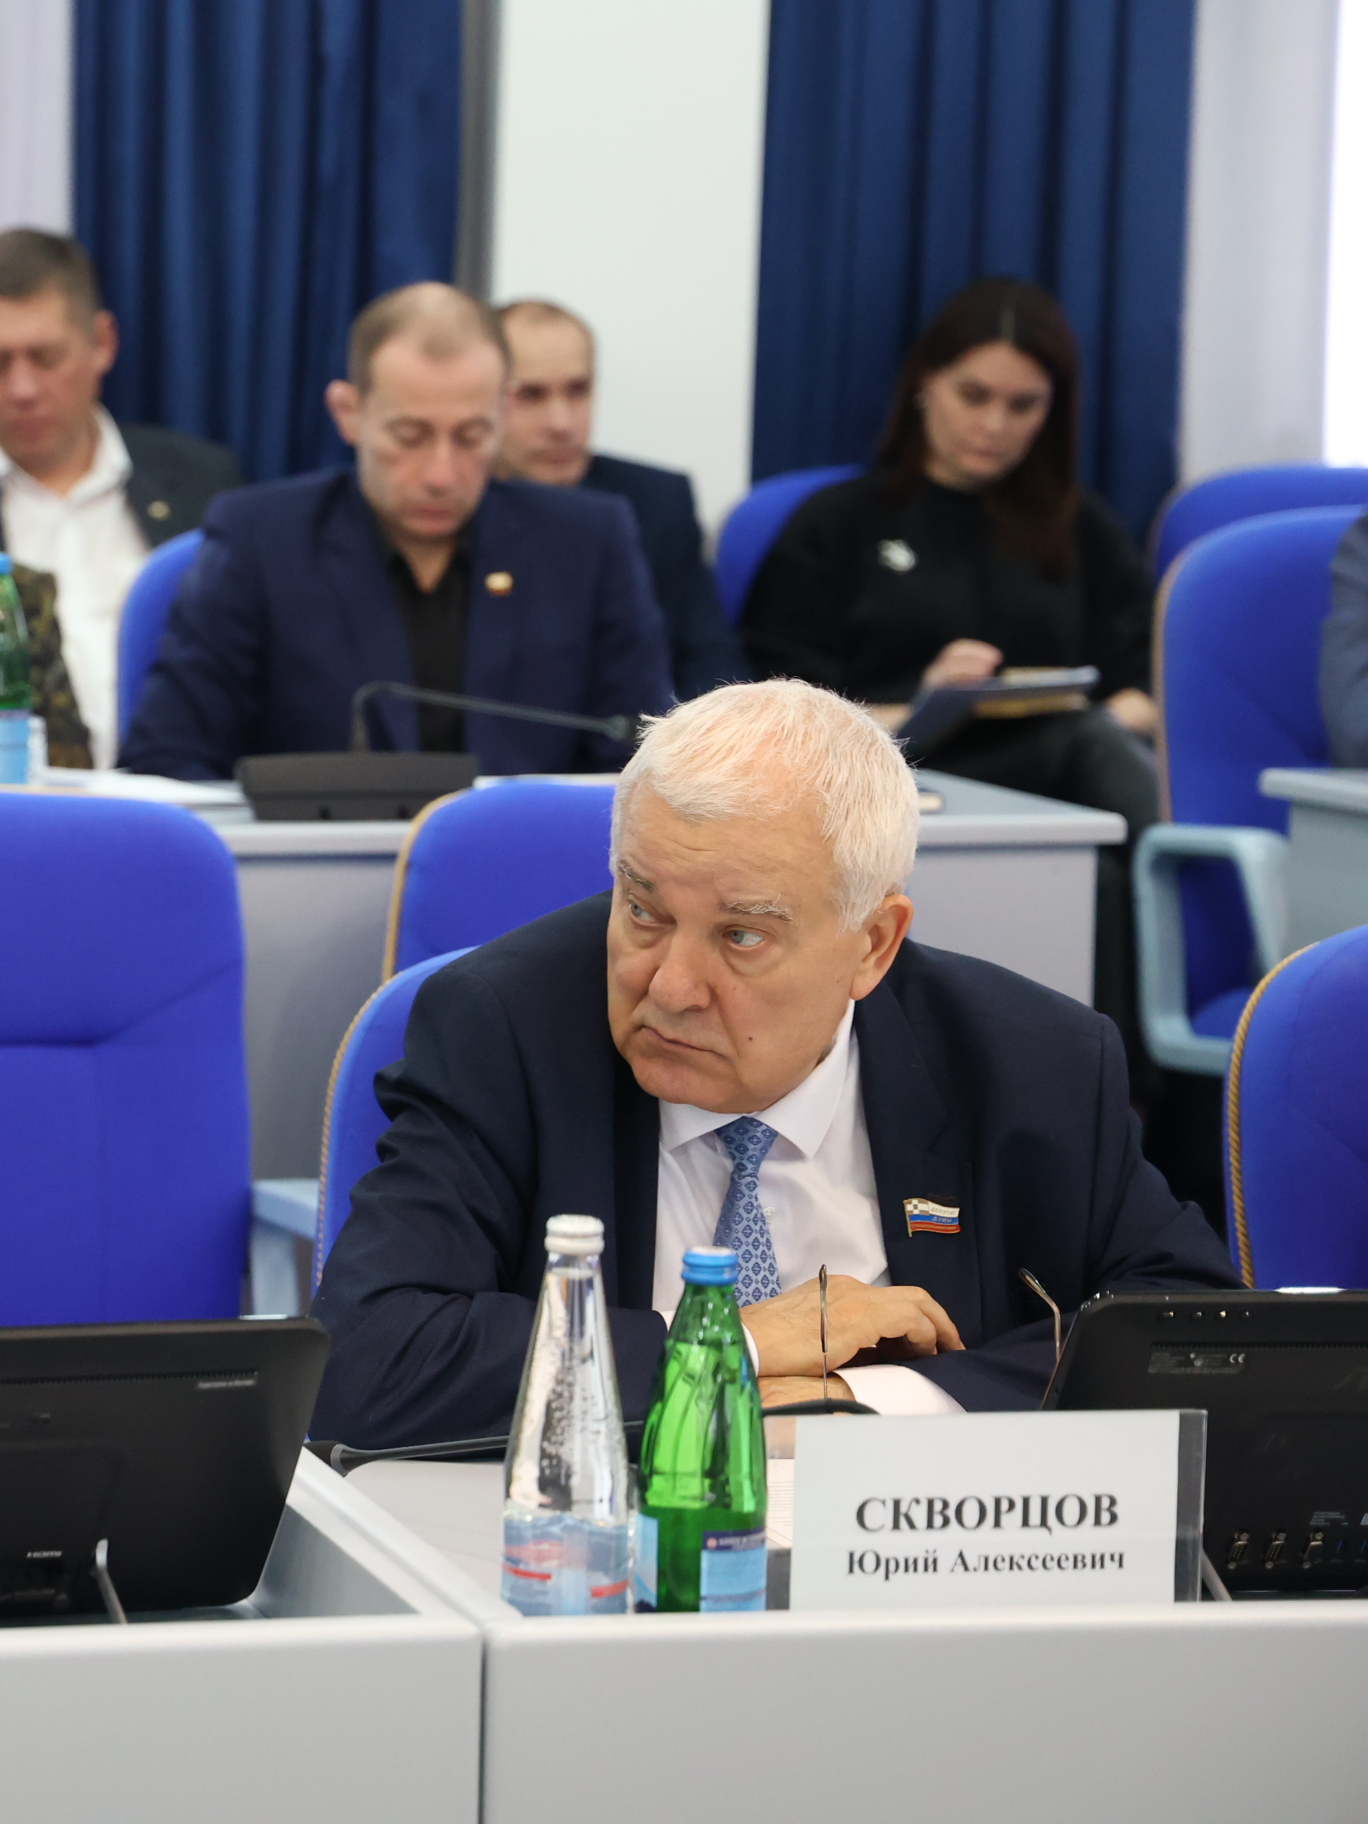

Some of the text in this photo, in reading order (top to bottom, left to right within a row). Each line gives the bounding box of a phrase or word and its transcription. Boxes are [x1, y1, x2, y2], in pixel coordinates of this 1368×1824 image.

[855, 1493, 1120, 1535] СКВОРЦОВ
[846, 1549, 1125, 1582] Юрий Алексеевич
